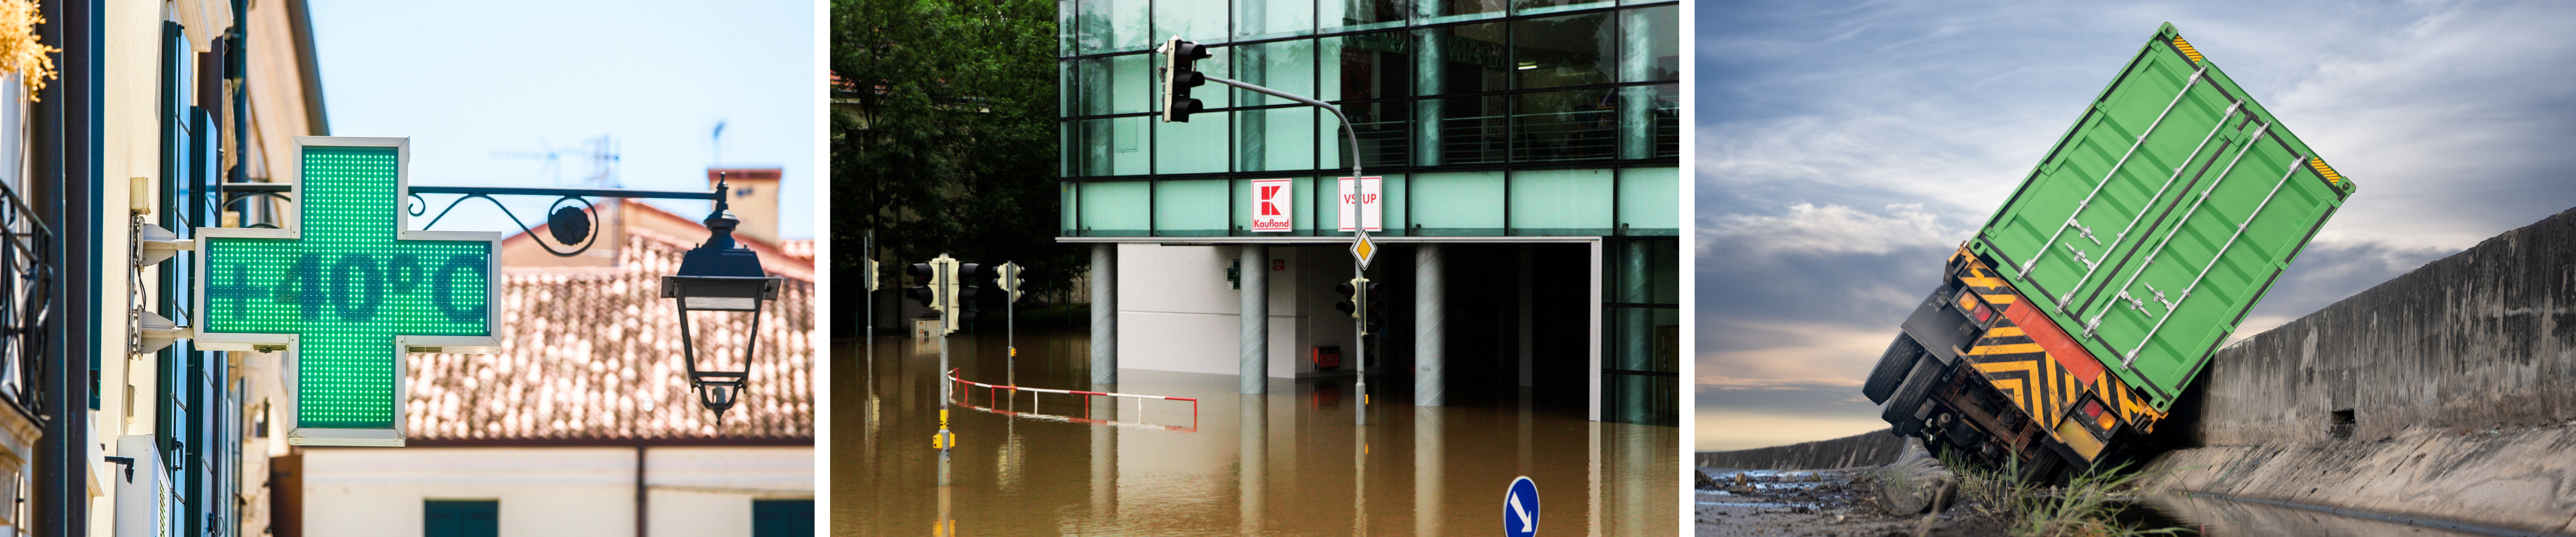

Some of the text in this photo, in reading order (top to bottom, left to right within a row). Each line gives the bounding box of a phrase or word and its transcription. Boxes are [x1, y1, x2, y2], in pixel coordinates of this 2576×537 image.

[1344, 193, 1376, 204] VSUP
[1254, 219, 1289, 228] Kaufland
[211, 254, 486, 322] +40°C
